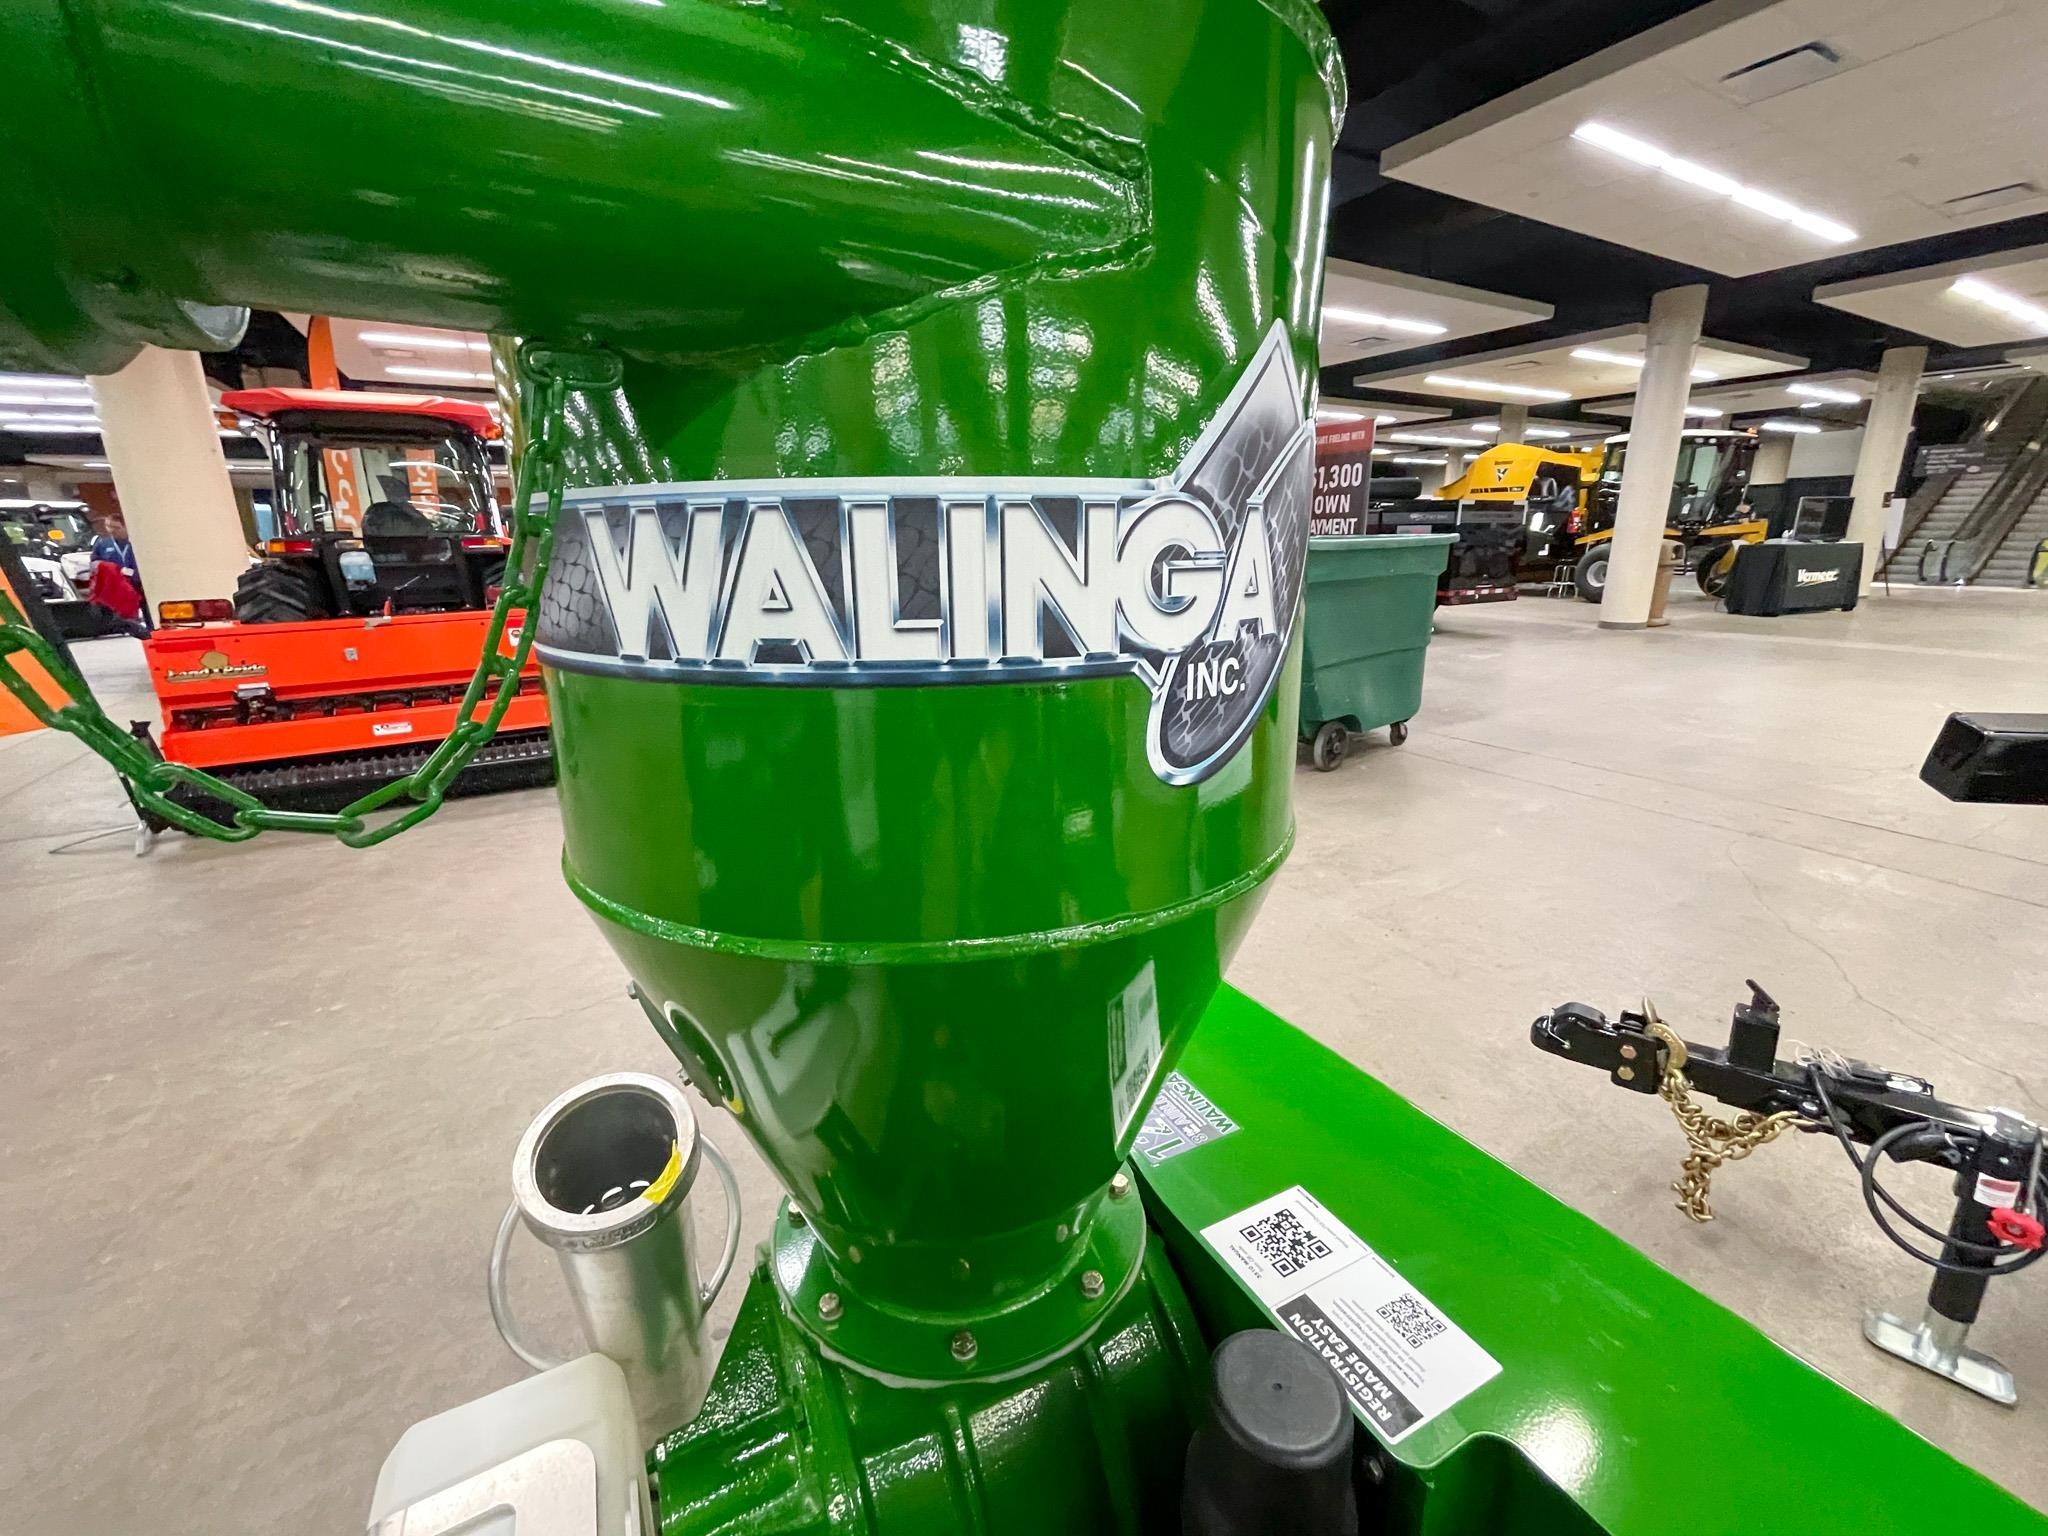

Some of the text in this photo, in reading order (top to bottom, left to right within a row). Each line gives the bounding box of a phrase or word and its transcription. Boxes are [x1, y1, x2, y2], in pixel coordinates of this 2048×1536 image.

[1310, 518, 1358, 535] AYMENT
[1314, 494, 1351, 514] OWN
[580, 496, 1277, 663] WALINGA
[1187, 657, 1245, 701] INC.
[1167, 1074, 1233, 1133] WALINGA
[1310, 1319, 1349, 1353] EASY
[1289, 1313, 1393, 1422] REGISTRATION
[1345, 1351, 1393, 1400] MADE
